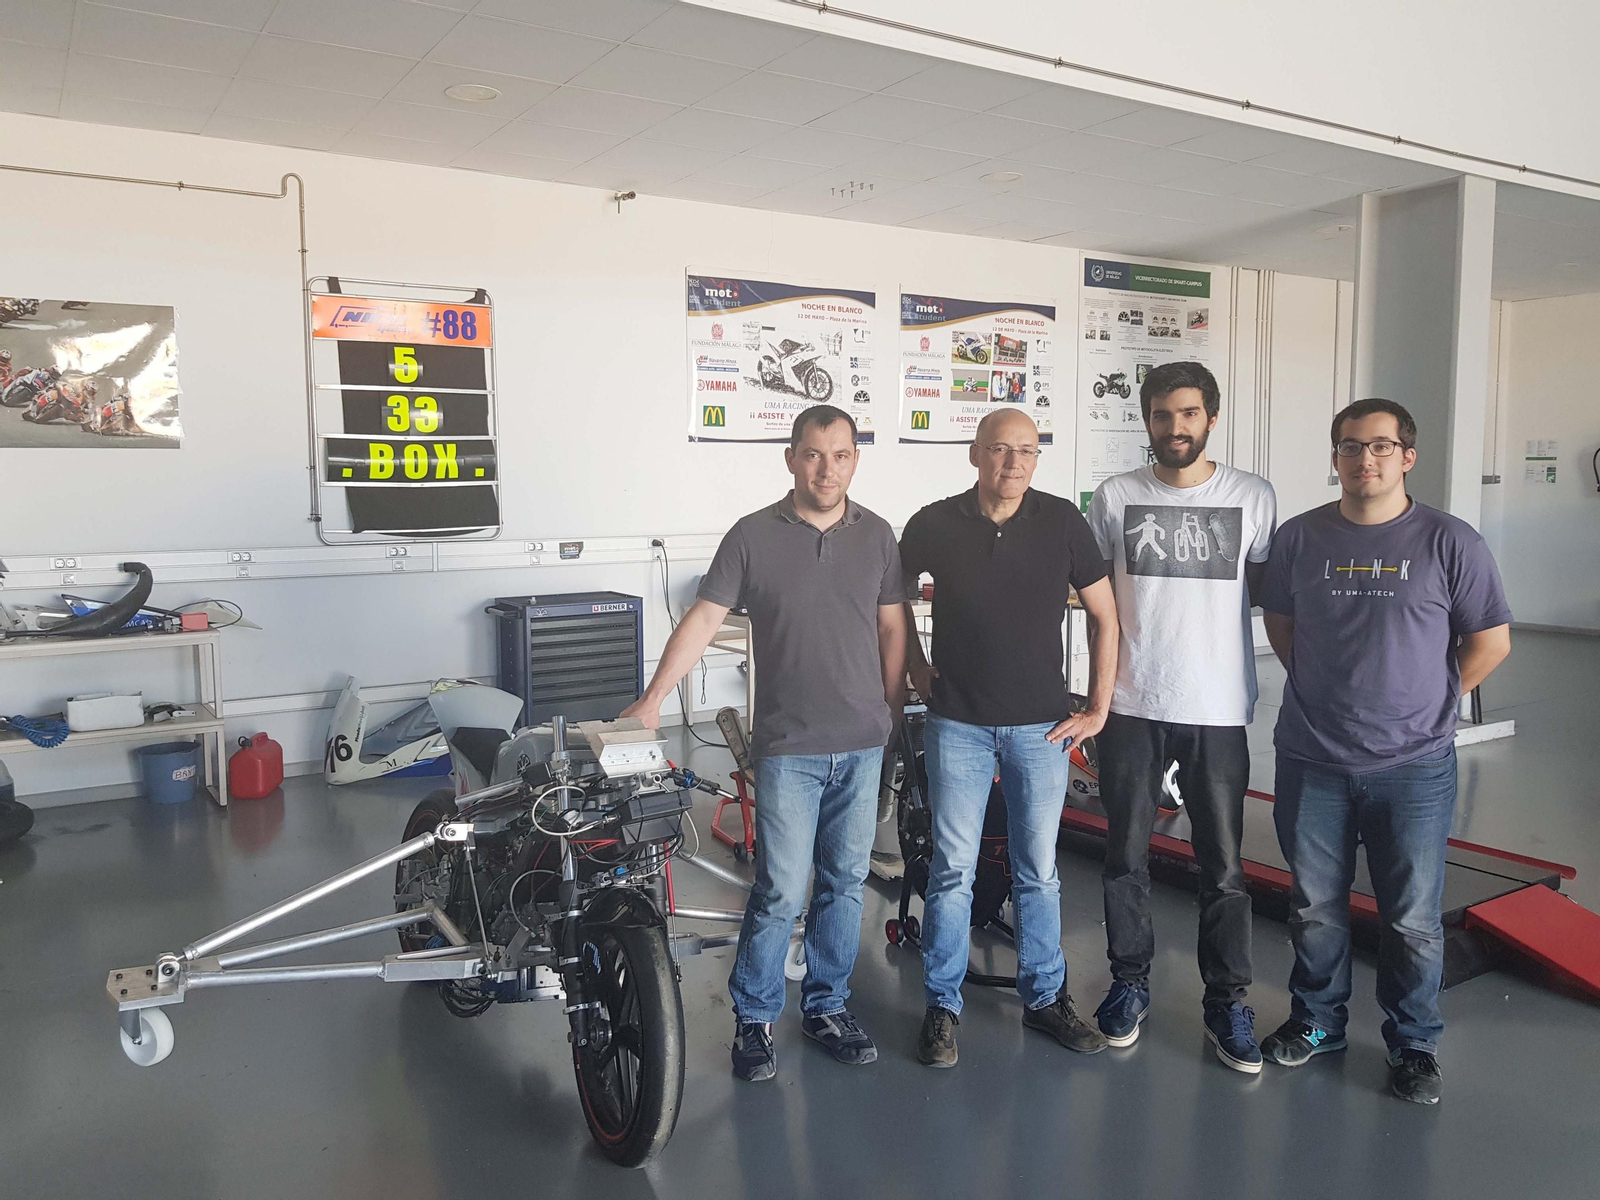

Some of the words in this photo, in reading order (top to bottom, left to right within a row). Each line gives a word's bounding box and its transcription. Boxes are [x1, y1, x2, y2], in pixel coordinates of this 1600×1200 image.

[704, 298, 742, 306] student
[802, 303, 826, 311] NOCHE
[838, 306, 863, 314] BLANCO
[420, 310, 478, 340] #88
[915, 314, 946, 322] student
[394, 346, 418, 384] 5
[705, 380, 738, 391] YAMAHA
[914, 388, 940, 398] YAMAHA
[387, 394, 438, 433] 33
[369, 443, 458, 480] BOX
[1324, 558, 1410, 580] LINK
